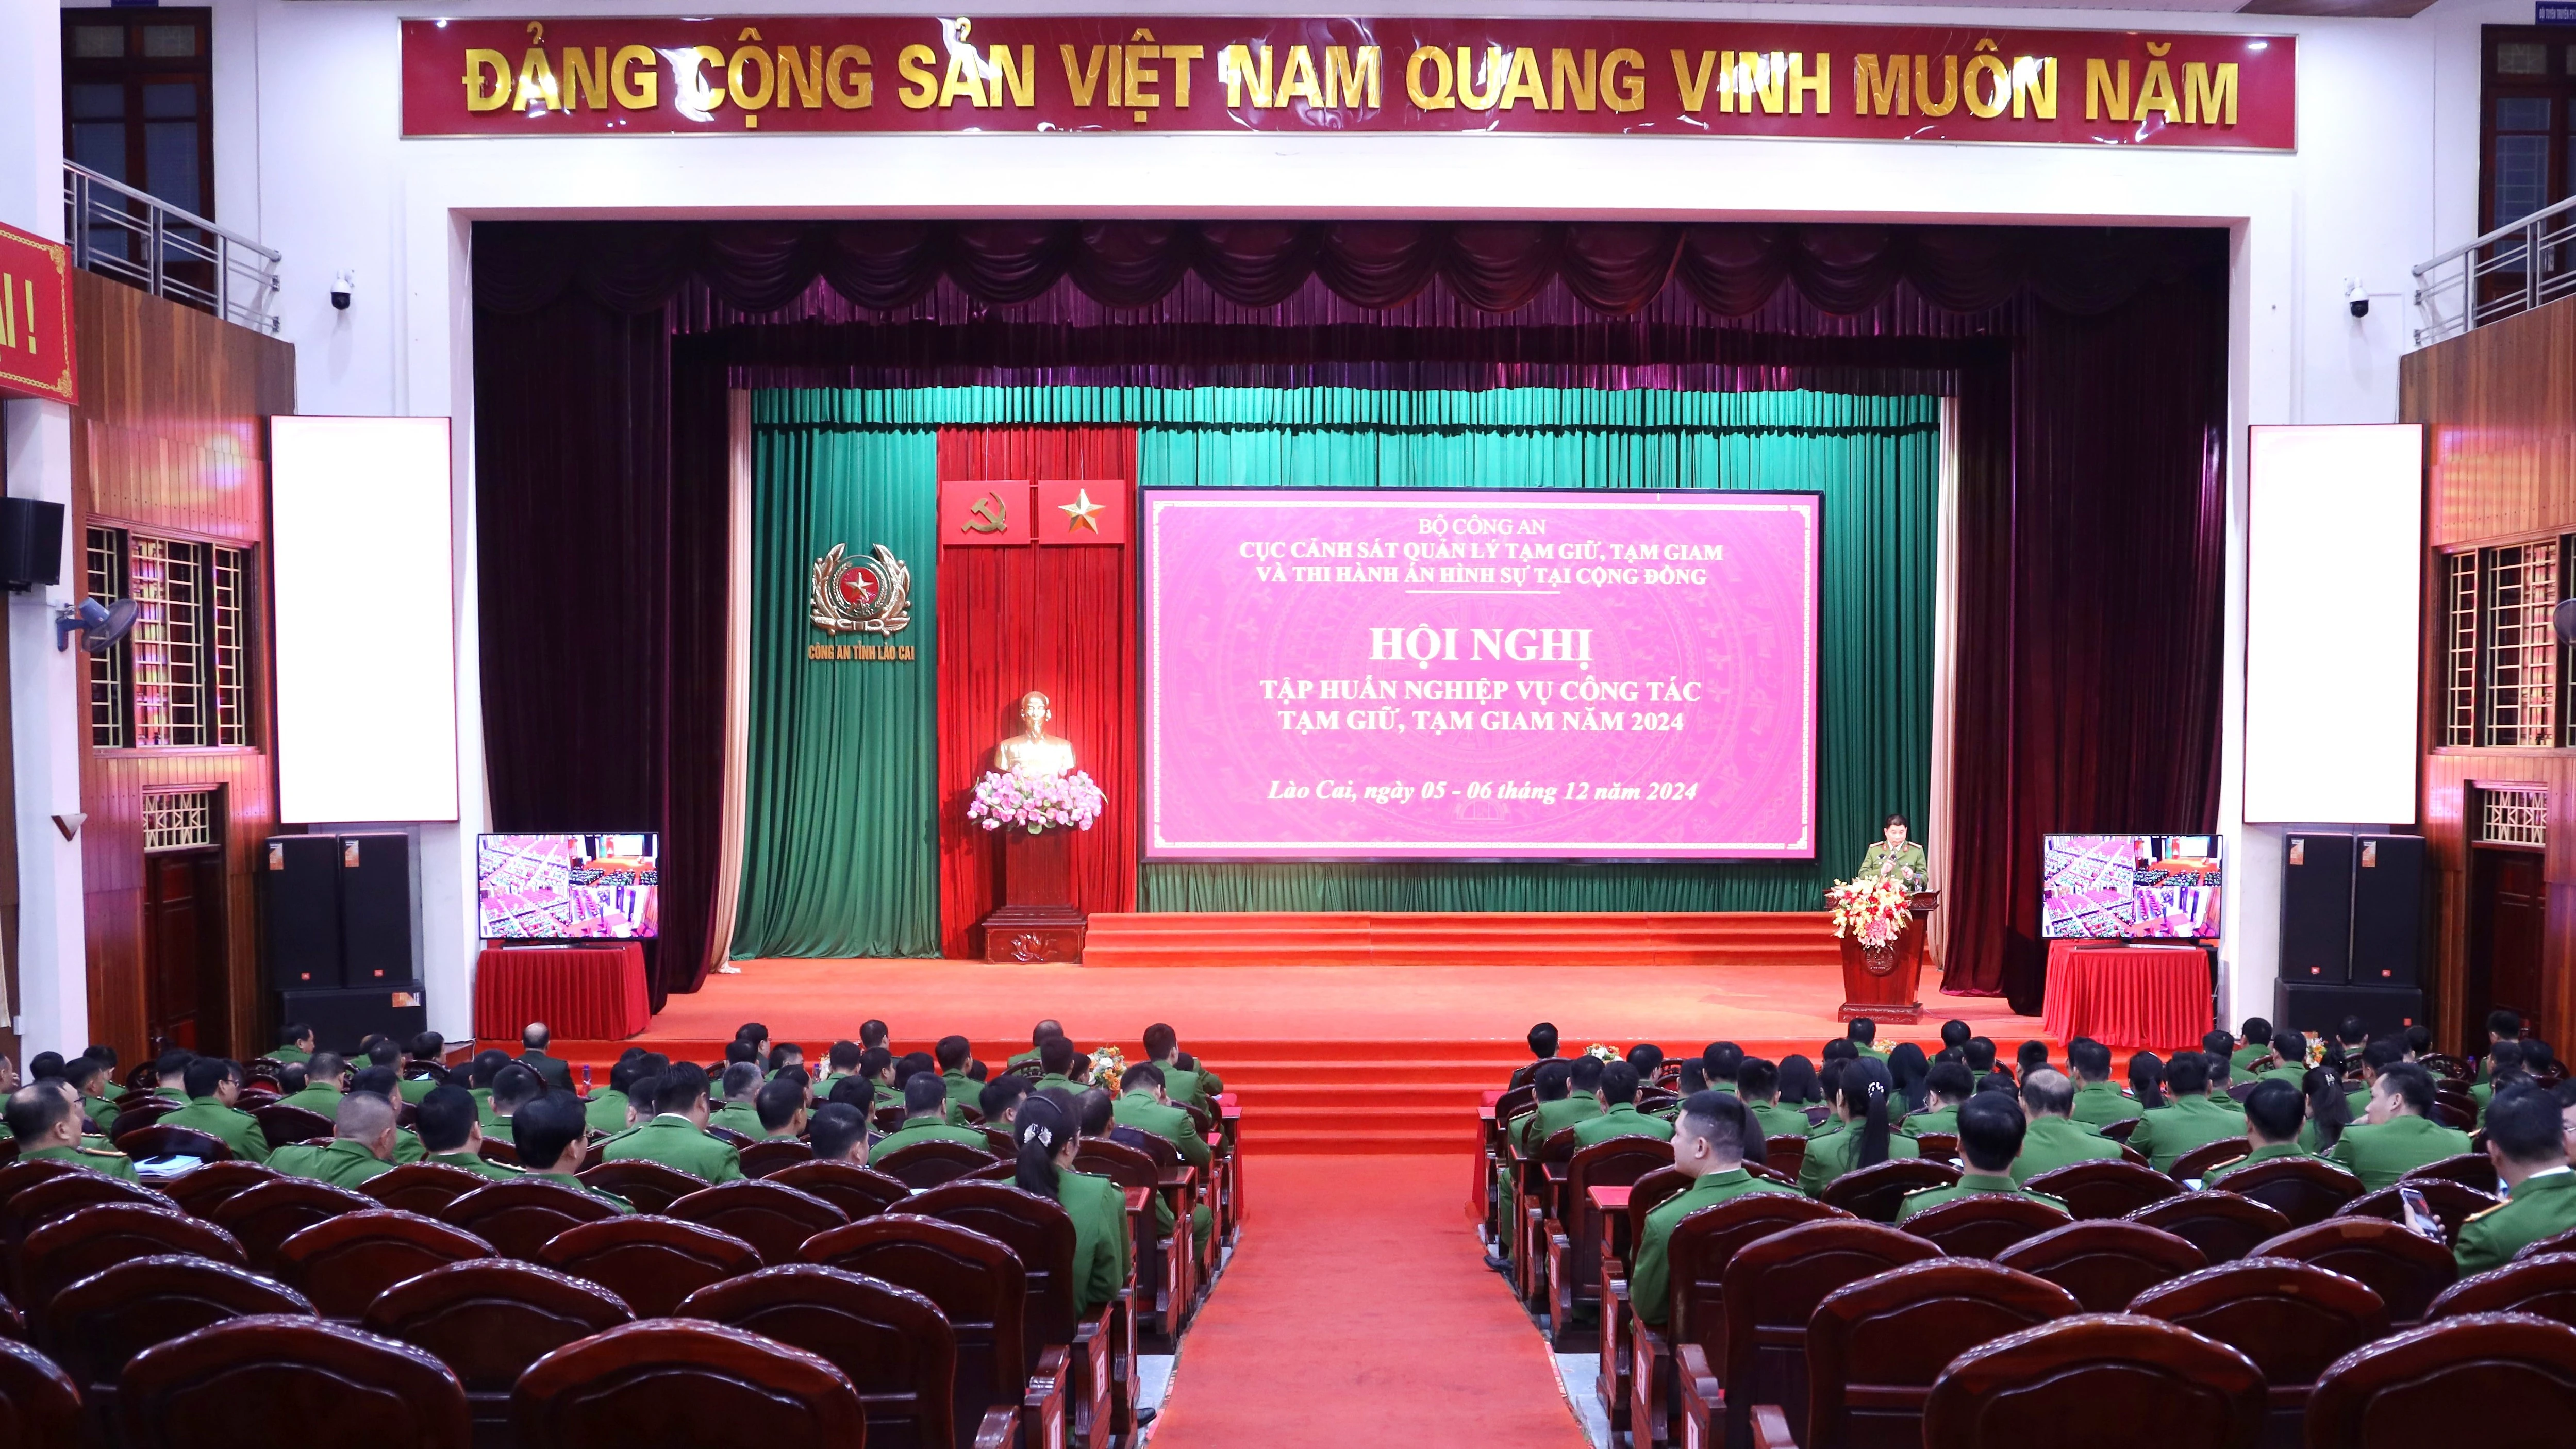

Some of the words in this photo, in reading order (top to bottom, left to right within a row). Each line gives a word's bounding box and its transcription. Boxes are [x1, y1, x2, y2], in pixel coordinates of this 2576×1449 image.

[462, 21, 658, 111] ĐẢNG
[691, 28, 872, 128] CỘNG
[898, 18, 1034, 109] SẢN
[1060, 29, 1203, 122] VIỆT
[1227, 44, 1380, 108] NAM
[1406, 46, 1645, 112] QUANG
[1671, 49, 1830, 115] VINH
[1856, 39, 2057, 119] MUÔN
[2086, 41, 2239, 125] NĂM
[1418, 514, 1448, 537] BỘ
[1452, 514, 1513, 535] CÔNG
[1517, 519, 1545, 535] AN
[1239, 541, 1286, 561] CỤC
[1290, 538, 1353, 558] CẢNH
[1357, 538, 1399, 558] SÁT
[1403, 538, 1466, 561] QUẢN
[1471, 539, 1500, 559] LÝ
[1505, 543, 1554, 563] TẠM
[1558, 540, 1605, 562] GIỮ,
[1610, 544, 1659, 564] TẠM
[1664, 544, 1723, 561] GIAM
[1256, 562, 1287, 582] VÀ
[1292, 566, 1331, 582] THI
[1336, 562, 1399, 582] HÀNH
[1404, 562, 1434, 582] ÁN
[1439, 562, 1495, 583] HÌNH
[1500, 565, 1531, 587] SỰ
[1534, 568, 1571, 588] TẠI
[1576, 565, 1639, 588] CỘNG
[1643, 564, 1707, 585] ĐỒNG
[808, 642, 835, 659] CÔNG
[836, 645, 850, 660] AN
[853, 640, 876, 660] TỈNH
[877, 642, 895, 660] LÀO
[898, 645, 915, 660] CAI
[1369, 623, 1459, 669] HỘI
[1470, 628, 1593, 670] NGHỊ
[1259, 677, 1313, 705] TẬP
[1319, 675, 1398, 699] HUẤN
[1404, 677, 1508, 705] NGHIỆP
[1516, 681, 1553, 706] VỤ
[1560, 675, 1639, 701] CÔNG
[1646, 676, 1701, 701] TÁC
[1278, 710, 1340, 735] TẠM
[1347, 706, 1405, 734] GIỮ,
[1412, 711, 1474, 736] TẠM
[1480, 711, 1554, 730] GIAM
[1562, 706, 1625, 731] NĂM
[1631, 712, 1684, 731] 2024
[1267, 780, 1310, 799] Lào
[1316, 780, 1357, 802] Cai,
[1364, 780, 1415, 804] ngày
[1421, 781, 1447, 799] 05
[1467, 781, 1492, 799] 06
[1497, 780, 1557, 805] tháng
[1564, 782, 1589, 800] 12
[1594, 781, 1640, 800] năm
[1646, 782, 1698, 800] 2024
